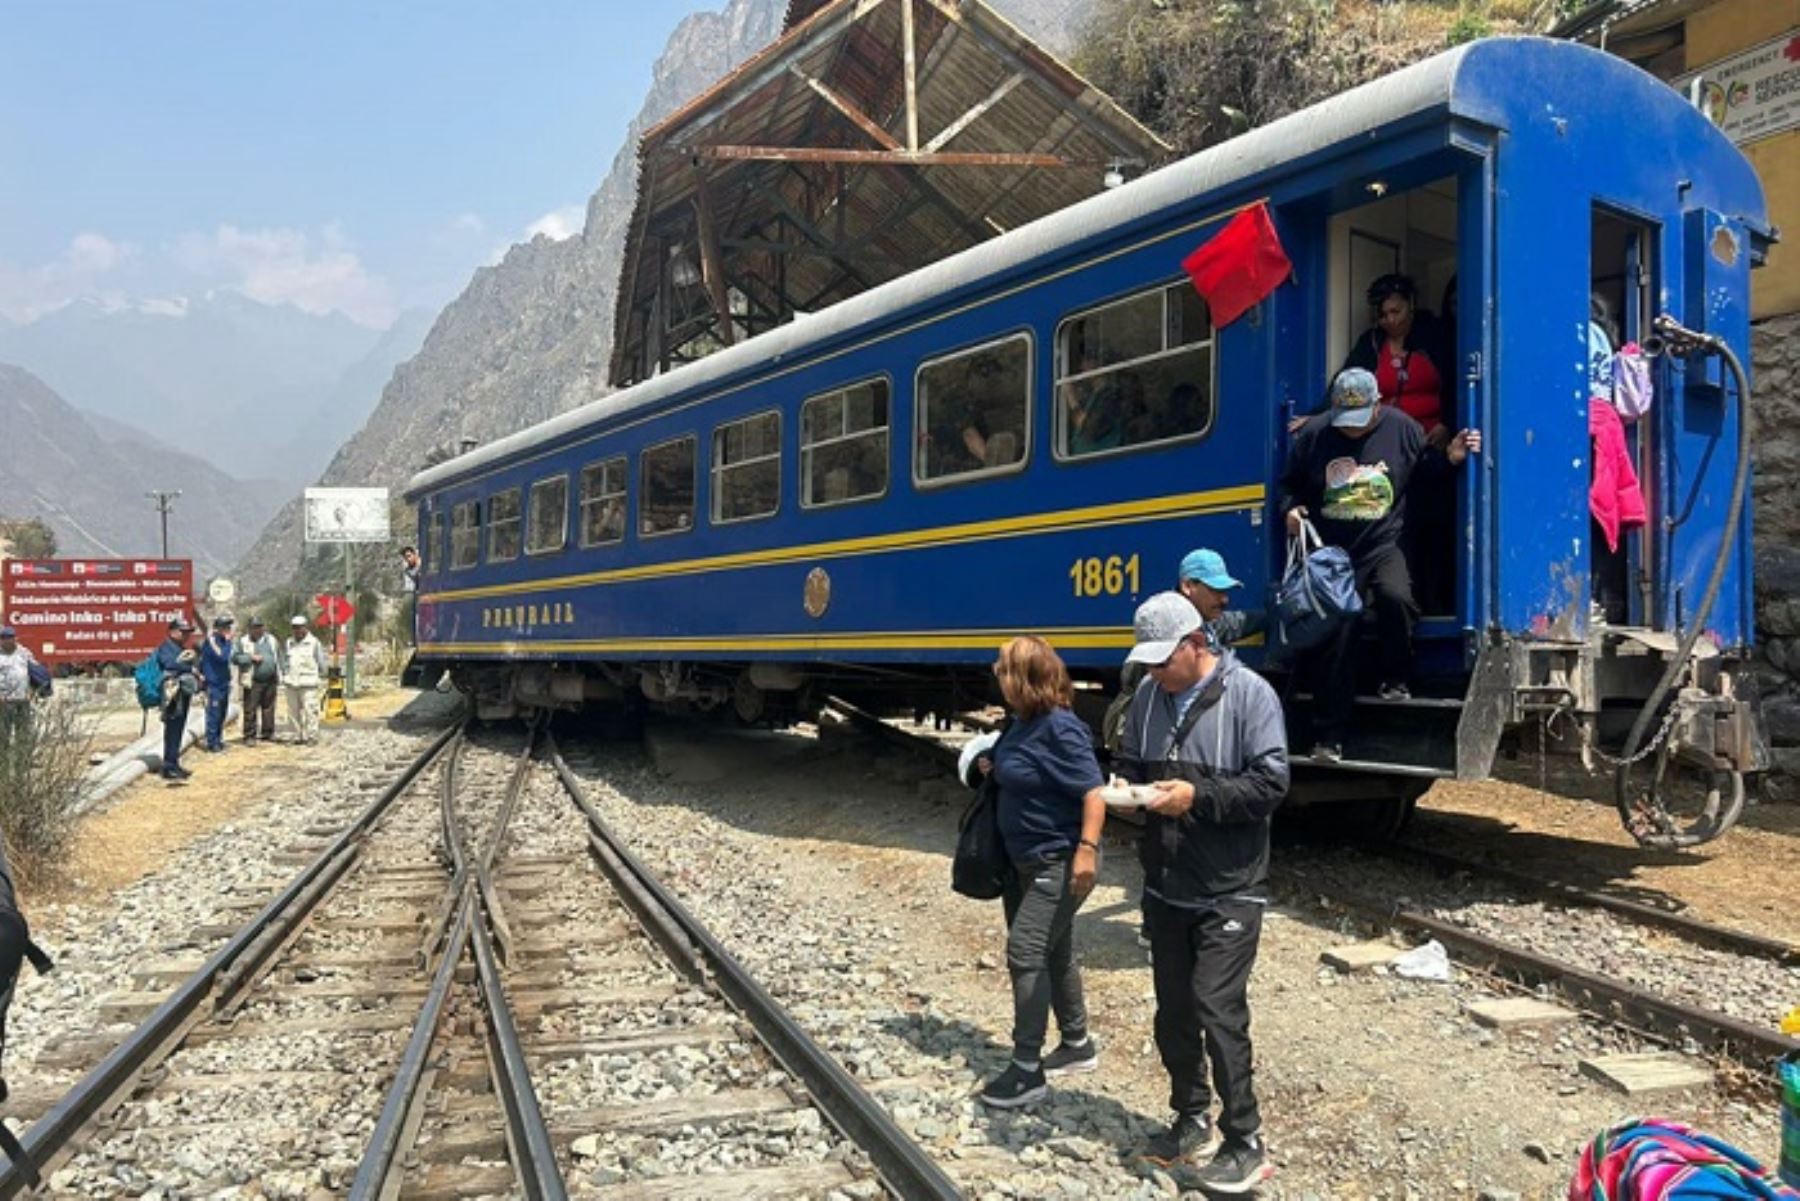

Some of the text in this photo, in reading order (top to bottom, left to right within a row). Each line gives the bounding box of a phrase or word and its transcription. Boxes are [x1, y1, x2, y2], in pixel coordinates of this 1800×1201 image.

[1069, 553, 1140, 597] 1861
[142, 579, 181, 588] Welcome
[10, 595, 60, 605] Santuario
[109, 594, 120, 604] de
[9, 610, 67, 625] Camino
[70, 610, 103, 624] Inka
[113, 609, 146, 623] Inka
[482, 602, 575, 628] PERURAIL
